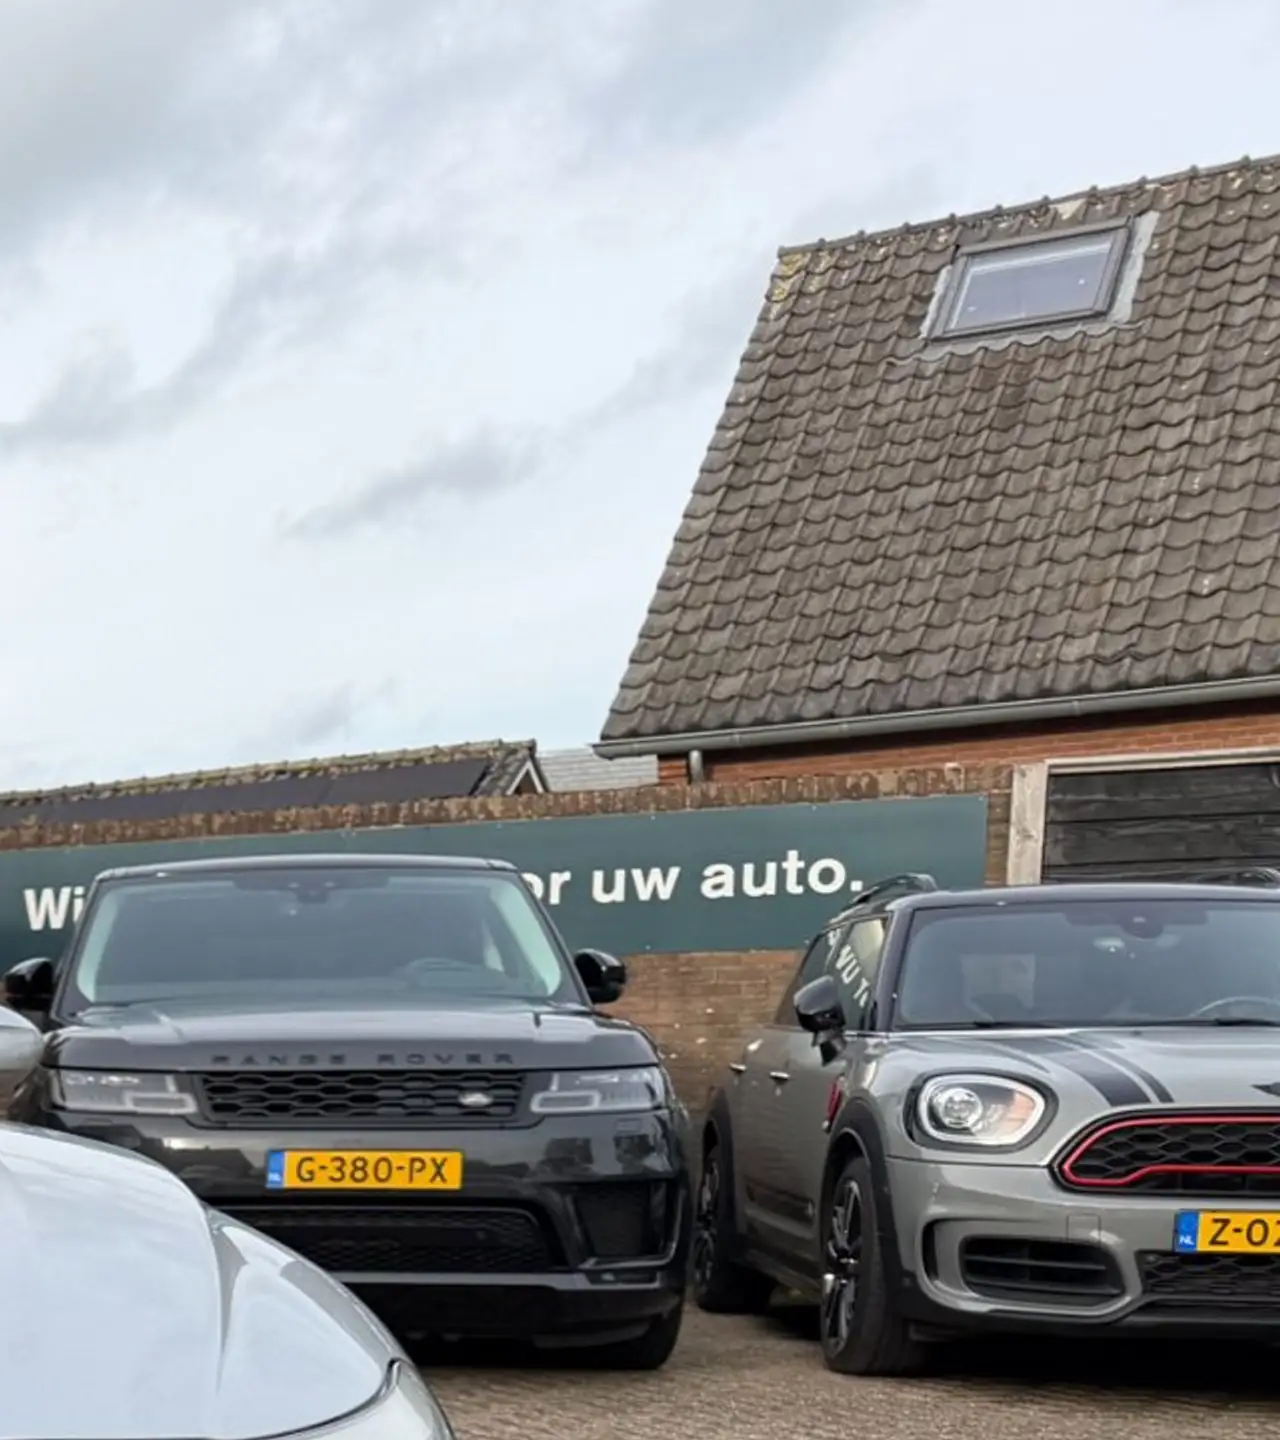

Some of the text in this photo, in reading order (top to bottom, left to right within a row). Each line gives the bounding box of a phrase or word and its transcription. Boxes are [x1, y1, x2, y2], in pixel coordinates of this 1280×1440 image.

[592, 866, 681, 904] uw
[700, 849, 863, 899] auto.
[211, 1053, 514, 1065] RANGE ROVER
[296, 1156, 448, 1183] G-380-PX
[1208, 1217, 1280, 1248] Z-0
